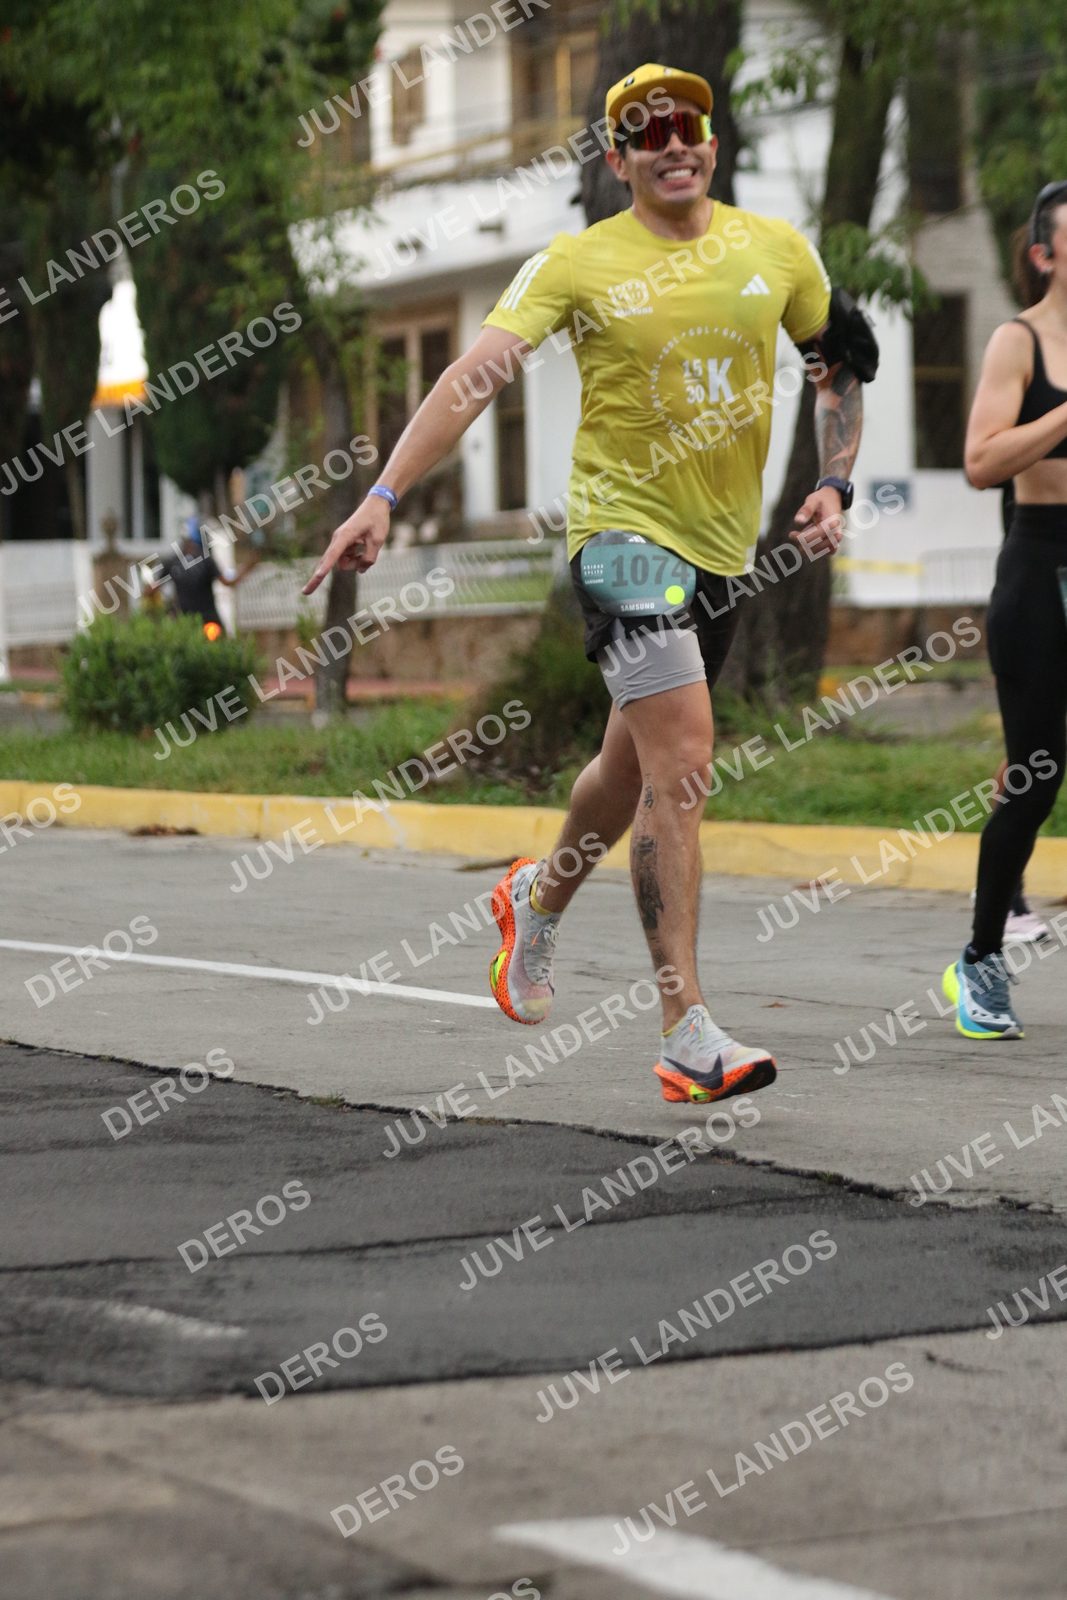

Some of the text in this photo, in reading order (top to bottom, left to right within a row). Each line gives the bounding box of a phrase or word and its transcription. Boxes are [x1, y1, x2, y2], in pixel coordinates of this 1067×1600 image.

[682, 358, 703, 378] 15
[707, 357, 735, 404] K
[685, 384, 705, 405] 30
[611, 554, 691, 588] 1074
[620, 601, 655, 612] SAMSUNG
